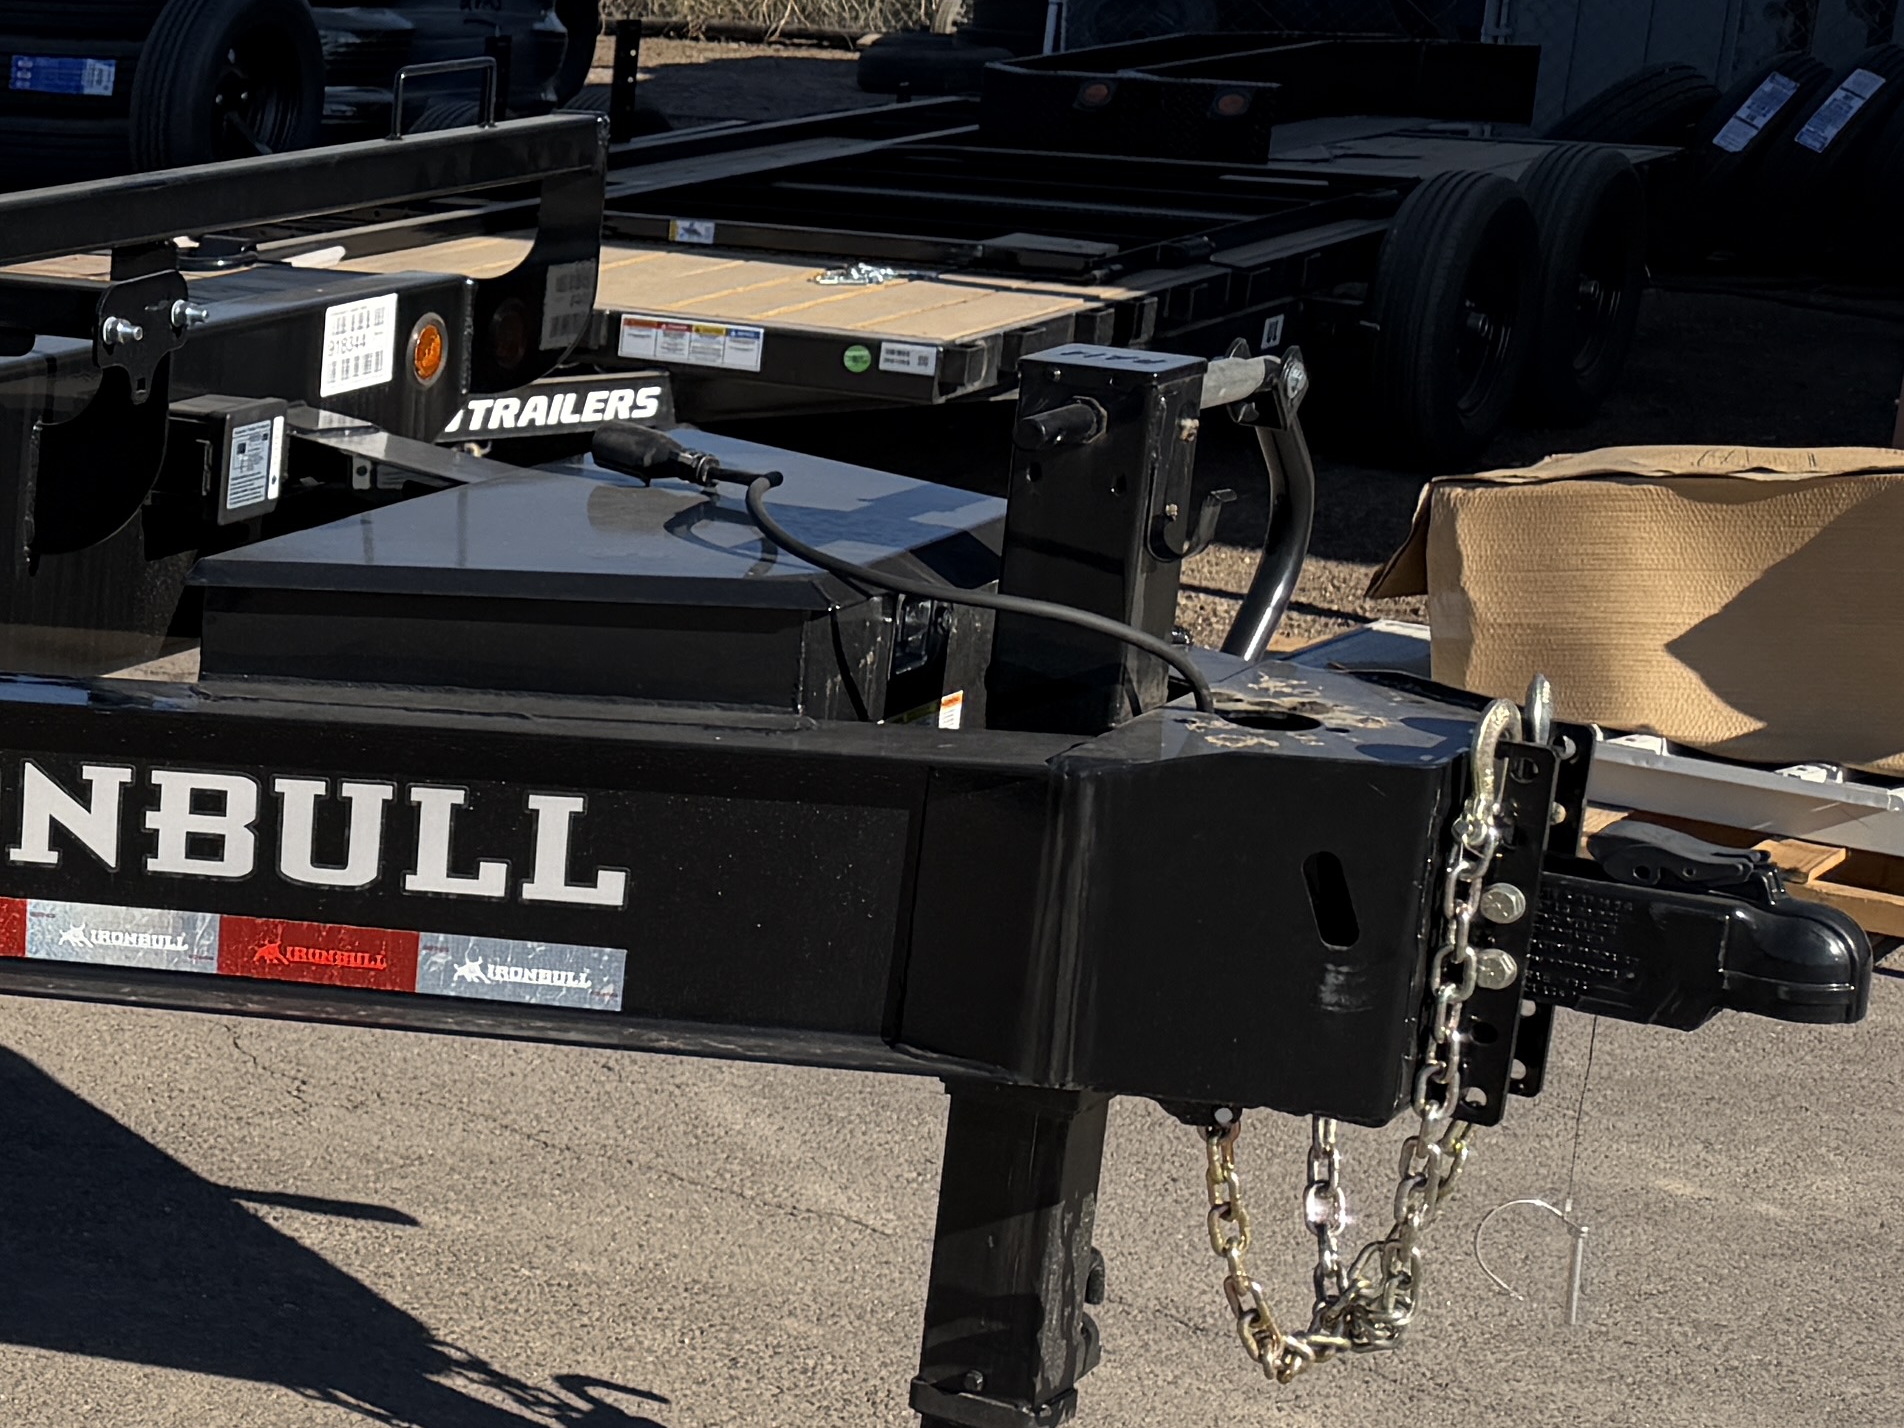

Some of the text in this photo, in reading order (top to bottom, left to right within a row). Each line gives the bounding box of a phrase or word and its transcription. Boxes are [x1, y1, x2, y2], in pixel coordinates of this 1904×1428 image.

[467, 387, 662, 431] TRAILERS
[91, 929, 189, 951] IRONBULL
[286, 945, 387, 970] IRONBULL
[488, 963, 592, 988] IRONBULL
